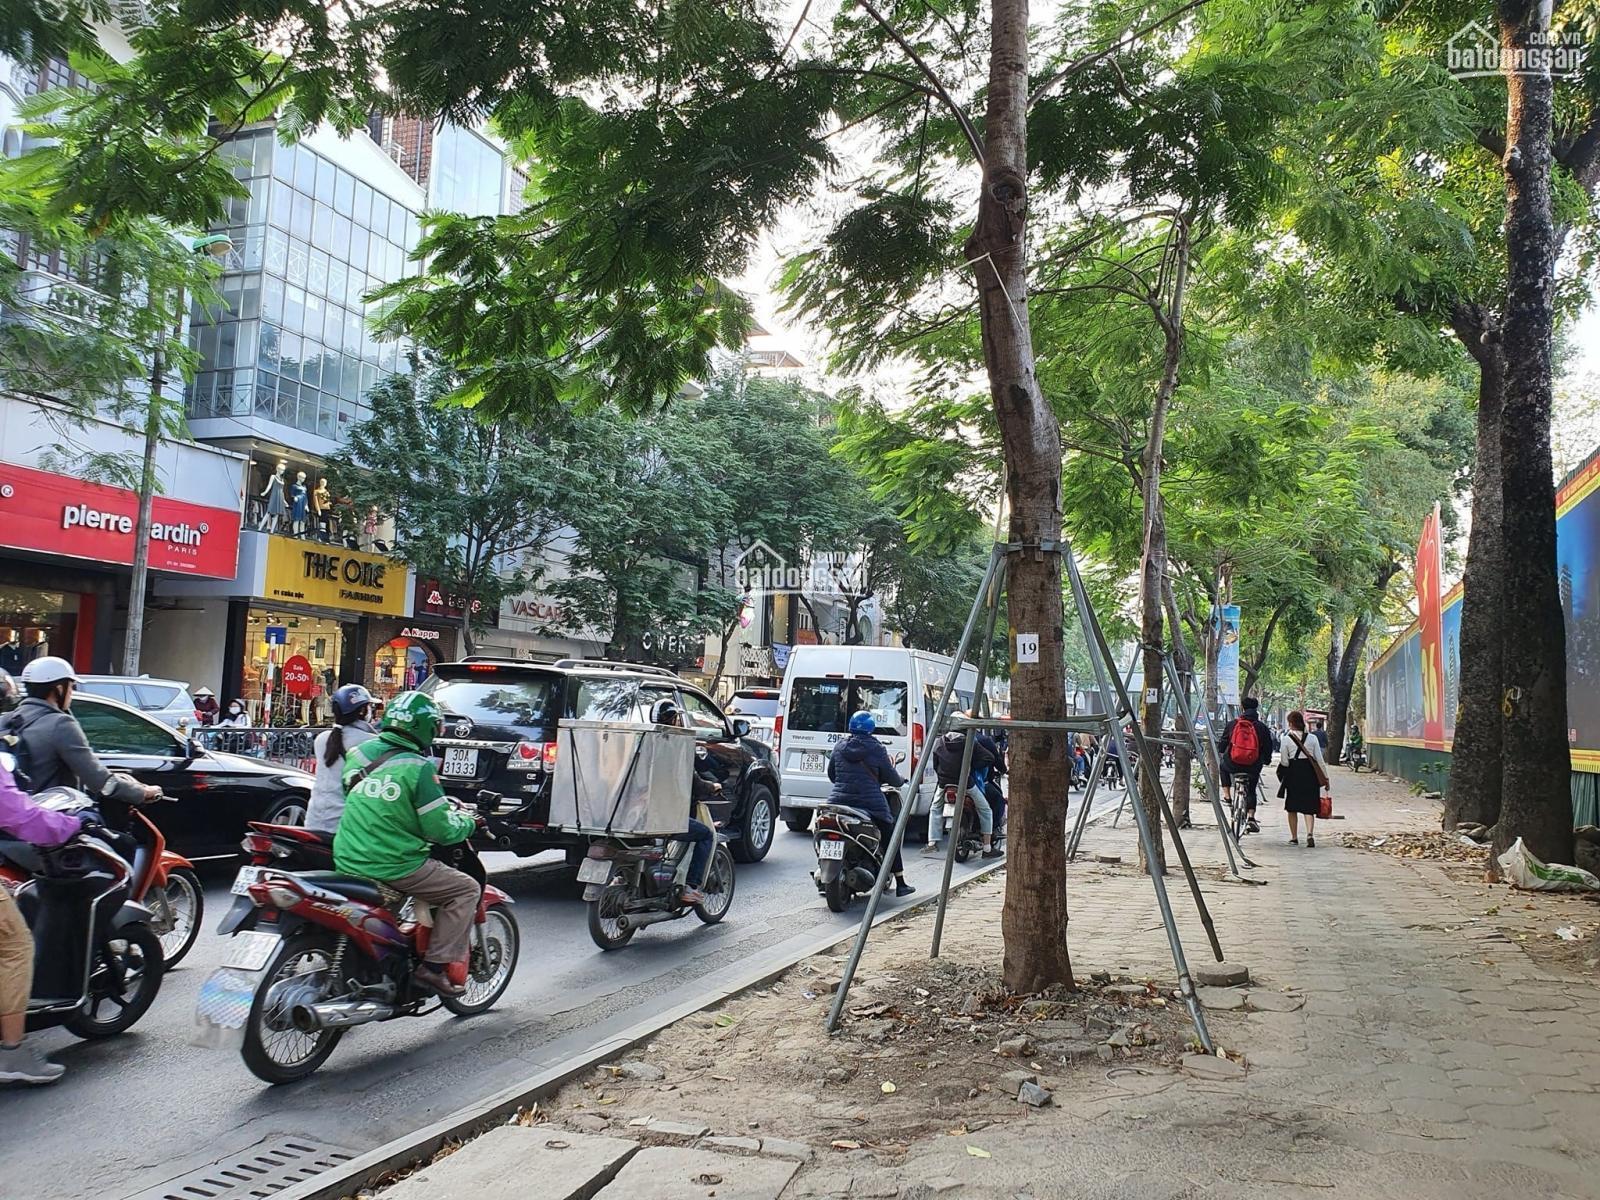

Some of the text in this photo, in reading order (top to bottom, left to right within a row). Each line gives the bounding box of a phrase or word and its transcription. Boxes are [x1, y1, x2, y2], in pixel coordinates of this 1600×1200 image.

[63, 504, 201, 546] pierre ardin
[167, 544, 198, 555] PARIS
[304, 551, 340, 581] THE
[339, 589, 384, 604] FASHION
[411, 628, 440, 640] Kappa
[1022, 642, 1037, 655] 19
[387, 709, 413, 723] Grab
[452, 749, 469, 762] 30A
[444, 762, 475, 776] 313.33
